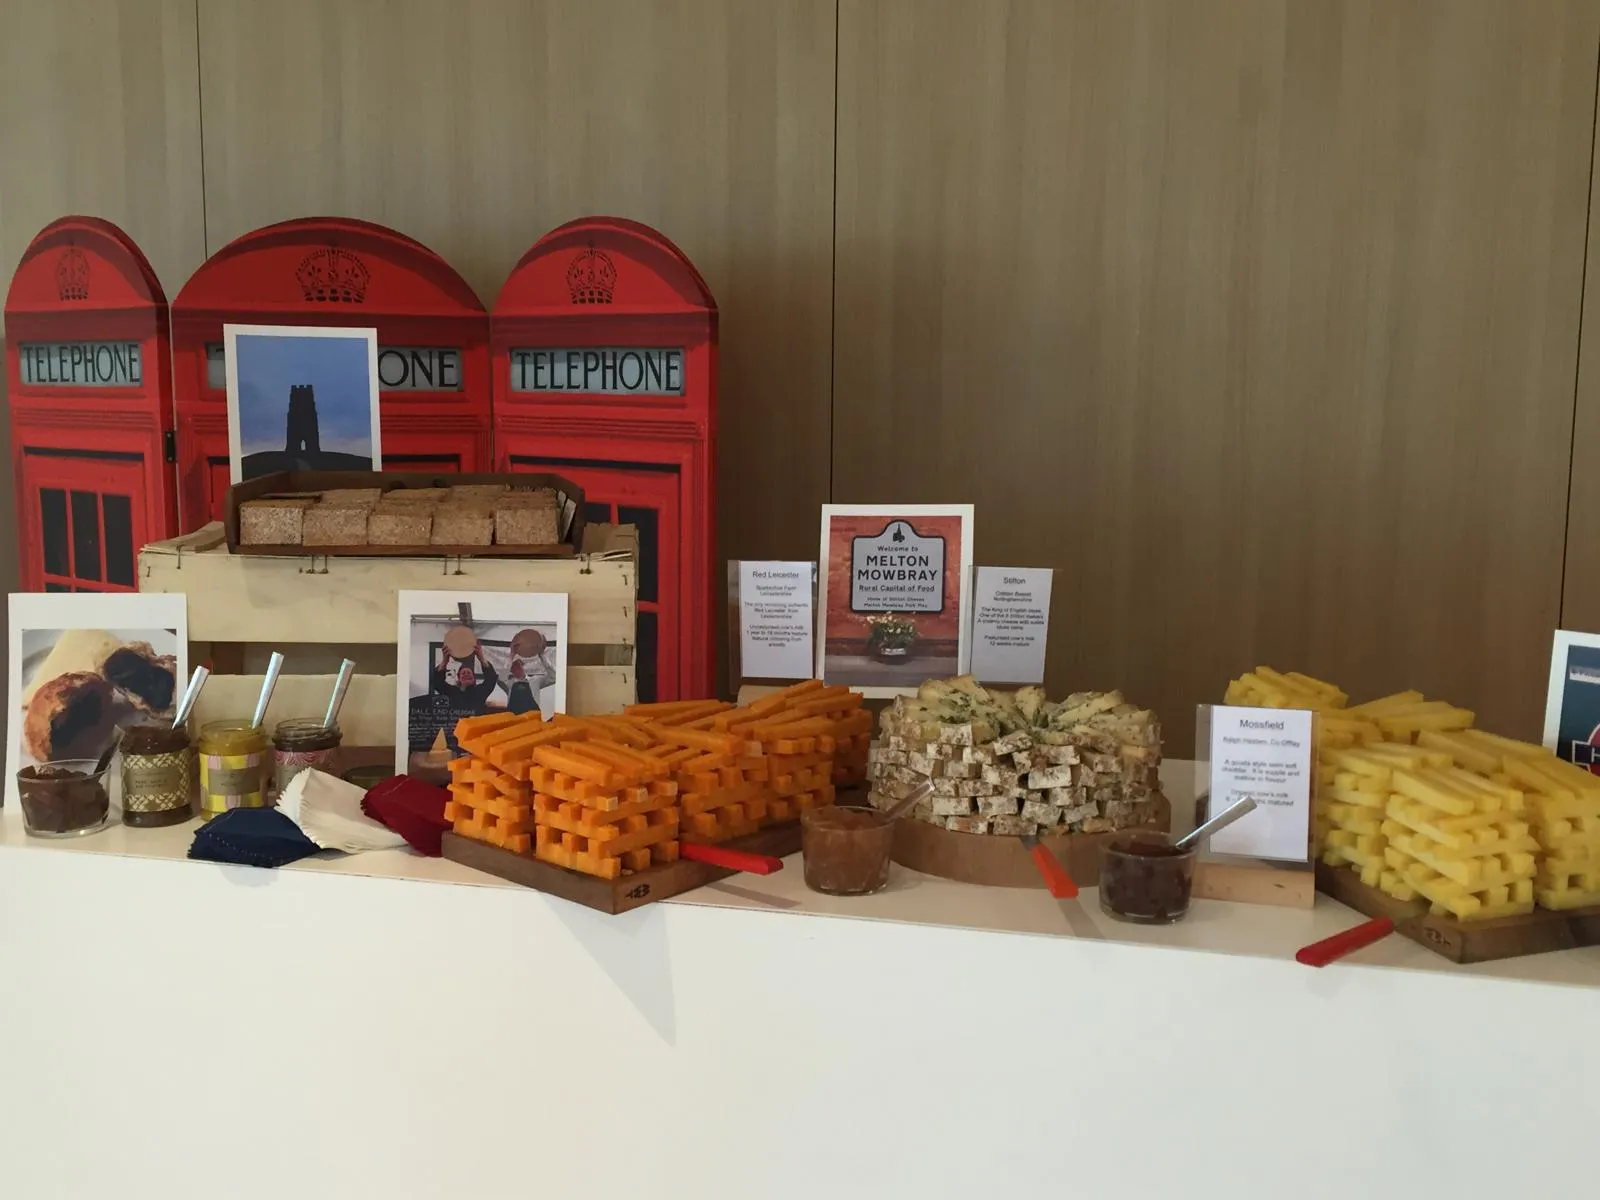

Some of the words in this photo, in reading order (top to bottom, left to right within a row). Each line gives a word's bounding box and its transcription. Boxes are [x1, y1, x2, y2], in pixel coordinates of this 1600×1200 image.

[23, 344, 141, 383] TELEPHONE
[516, 351, 681, 391] TELEPHONE
[866, 556, 929, 567] MELTON
[858, 570, 938, 580] MOWBRAY
[1240, 720, 1284, 730] Mossfield
